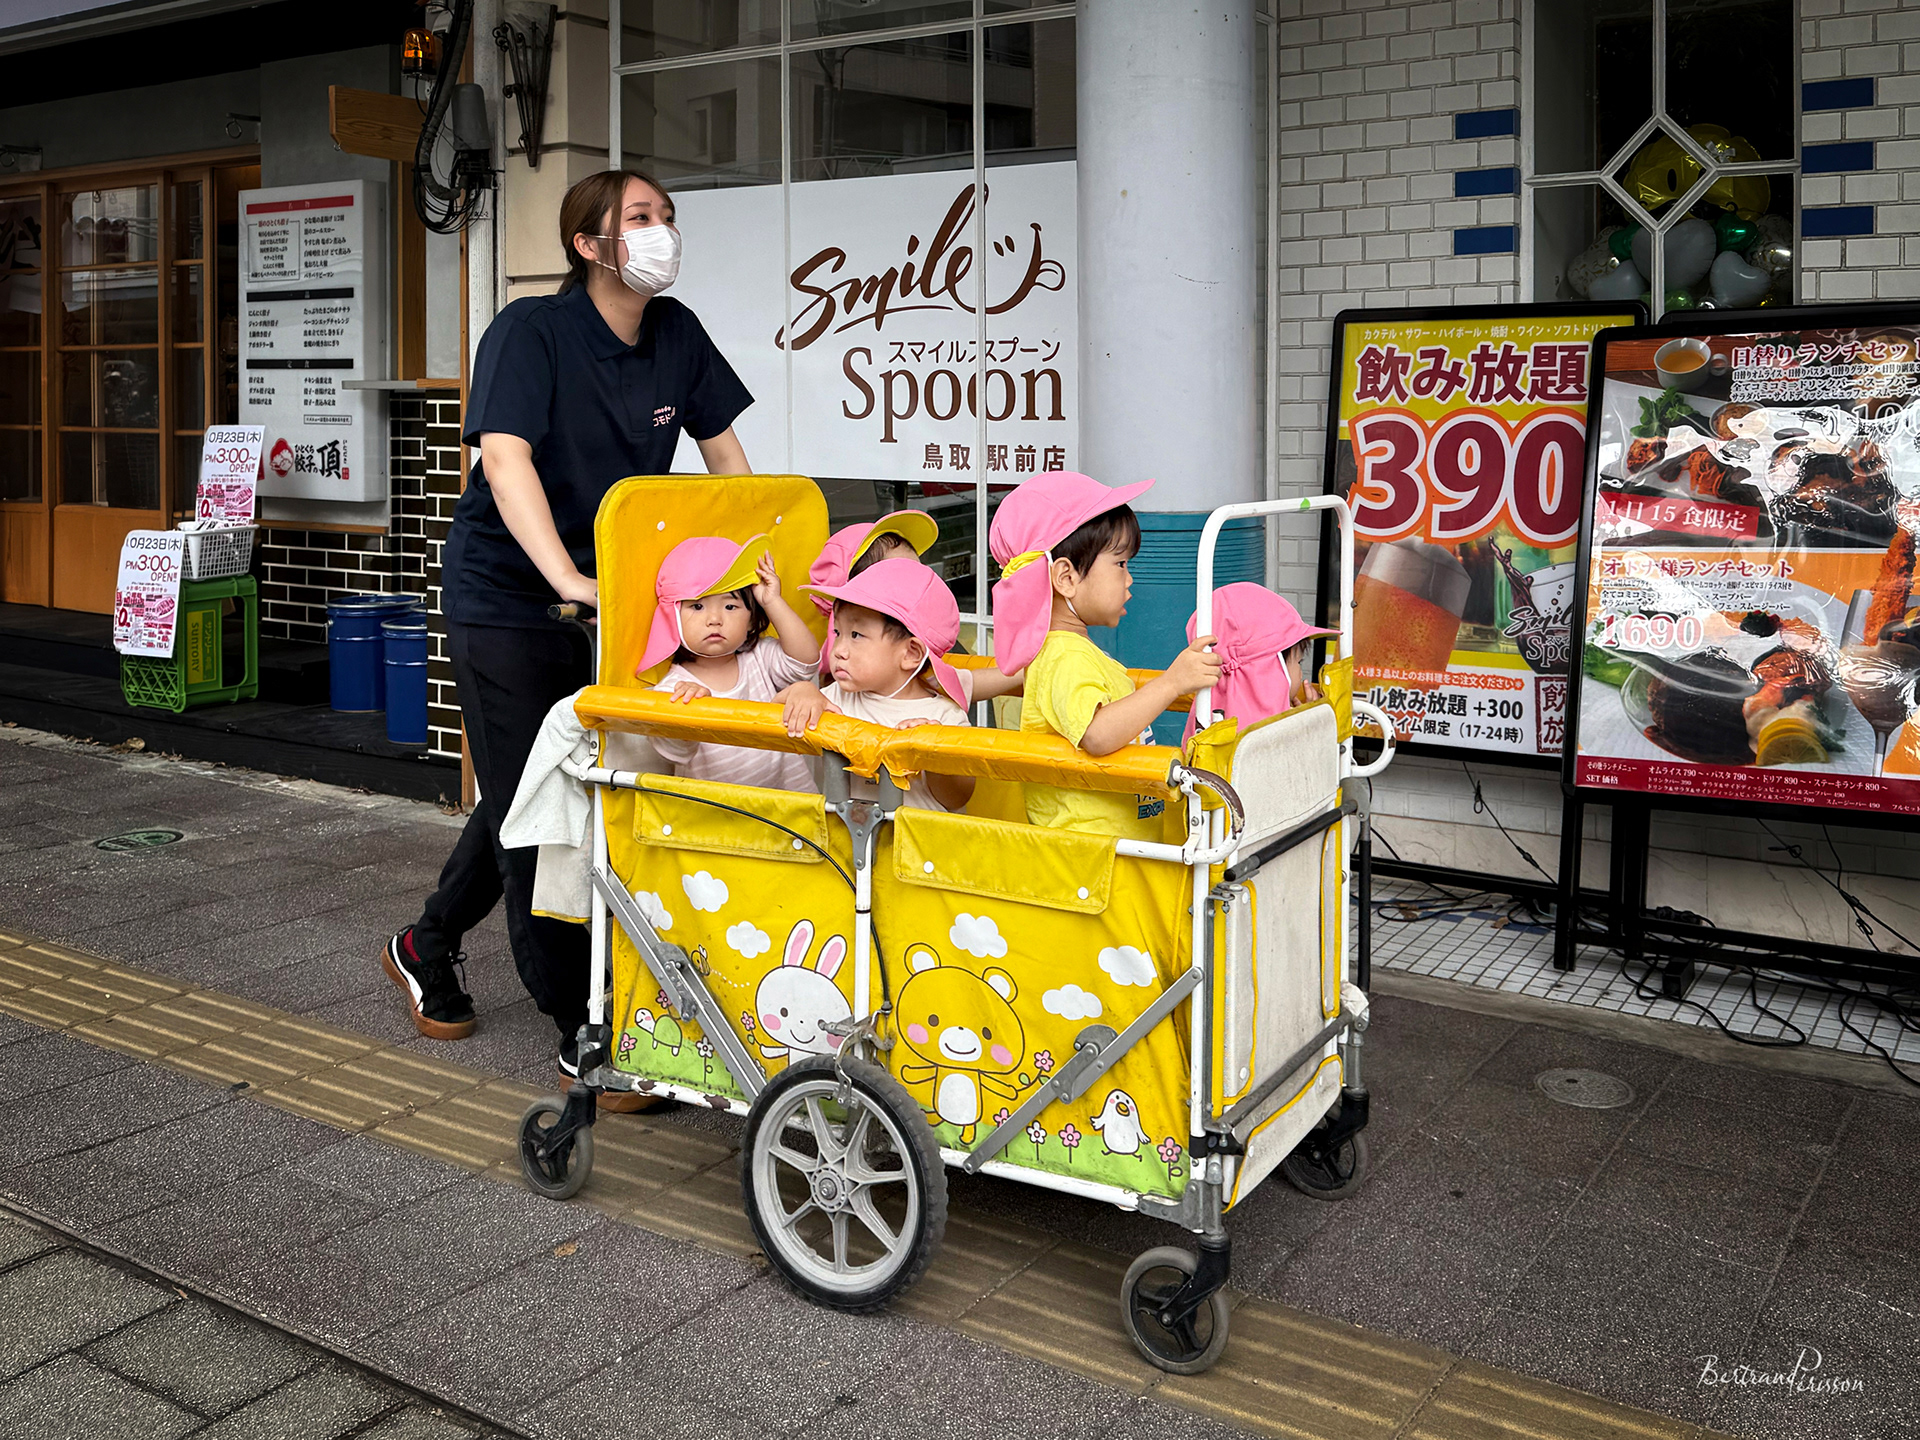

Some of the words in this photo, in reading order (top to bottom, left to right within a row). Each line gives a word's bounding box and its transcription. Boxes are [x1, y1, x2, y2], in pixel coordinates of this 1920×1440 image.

[775, 182, 990, 351] Smile
[1356, 343, 1590, 404] 飲み放題
[841, 345, 1067, 444] Spoon
[294, 444, 315, 454] ひとくち
[316, 439, 342, 480] 頂
[922, 442, 1066, 473] 鳥取駅前店
[1352, 415, 1586, 541] 390
[1603, 558, 1794, 579] オトナ様ランチセット
[1601, 614, 1704, 650] 1690
[1472, 698, 1524, 721] +300
